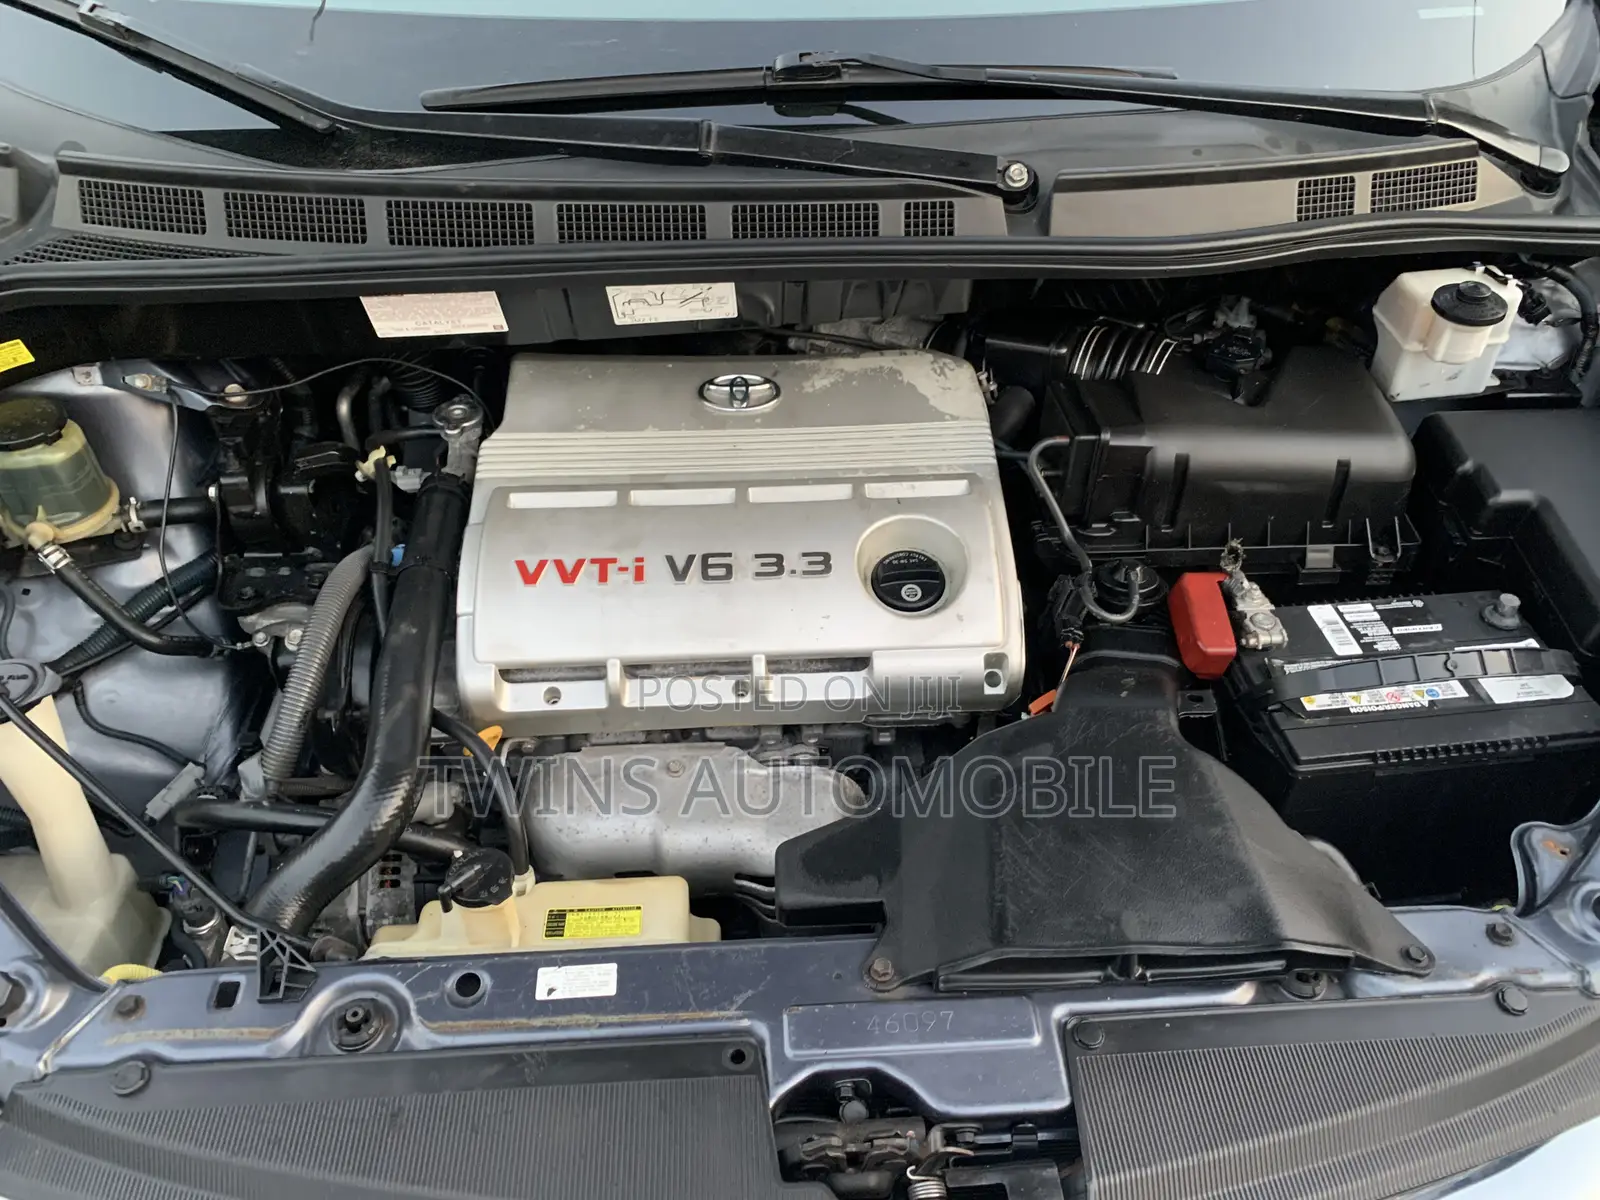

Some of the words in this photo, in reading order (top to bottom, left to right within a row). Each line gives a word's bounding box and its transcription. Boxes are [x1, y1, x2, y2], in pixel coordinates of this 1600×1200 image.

[514, 556, 646, 587] VVT-i
[665, 552, 734, 585] V6
[753, 551, 833, 580] 3.3
[866, 1010, 955, 1035] 46097
